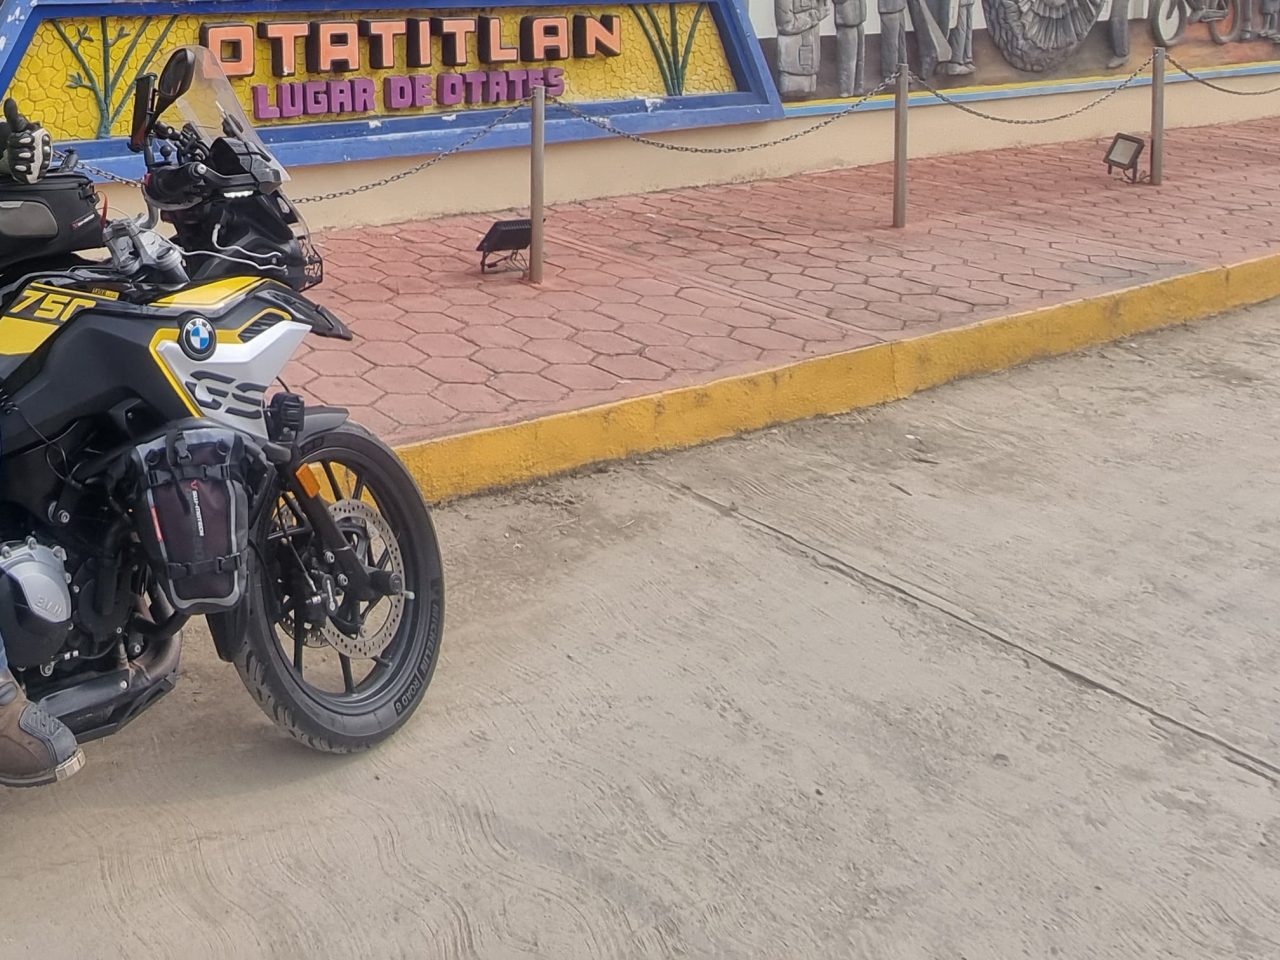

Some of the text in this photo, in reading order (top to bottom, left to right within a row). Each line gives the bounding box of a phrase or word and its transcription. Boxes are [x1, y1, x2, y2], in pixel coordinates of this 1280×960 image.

[199, 14, 621, 79] OTATITLAN
[253, 67, 565, 120] LUGAR DE OTATES
[401, 676, 421, 706] ROAD
